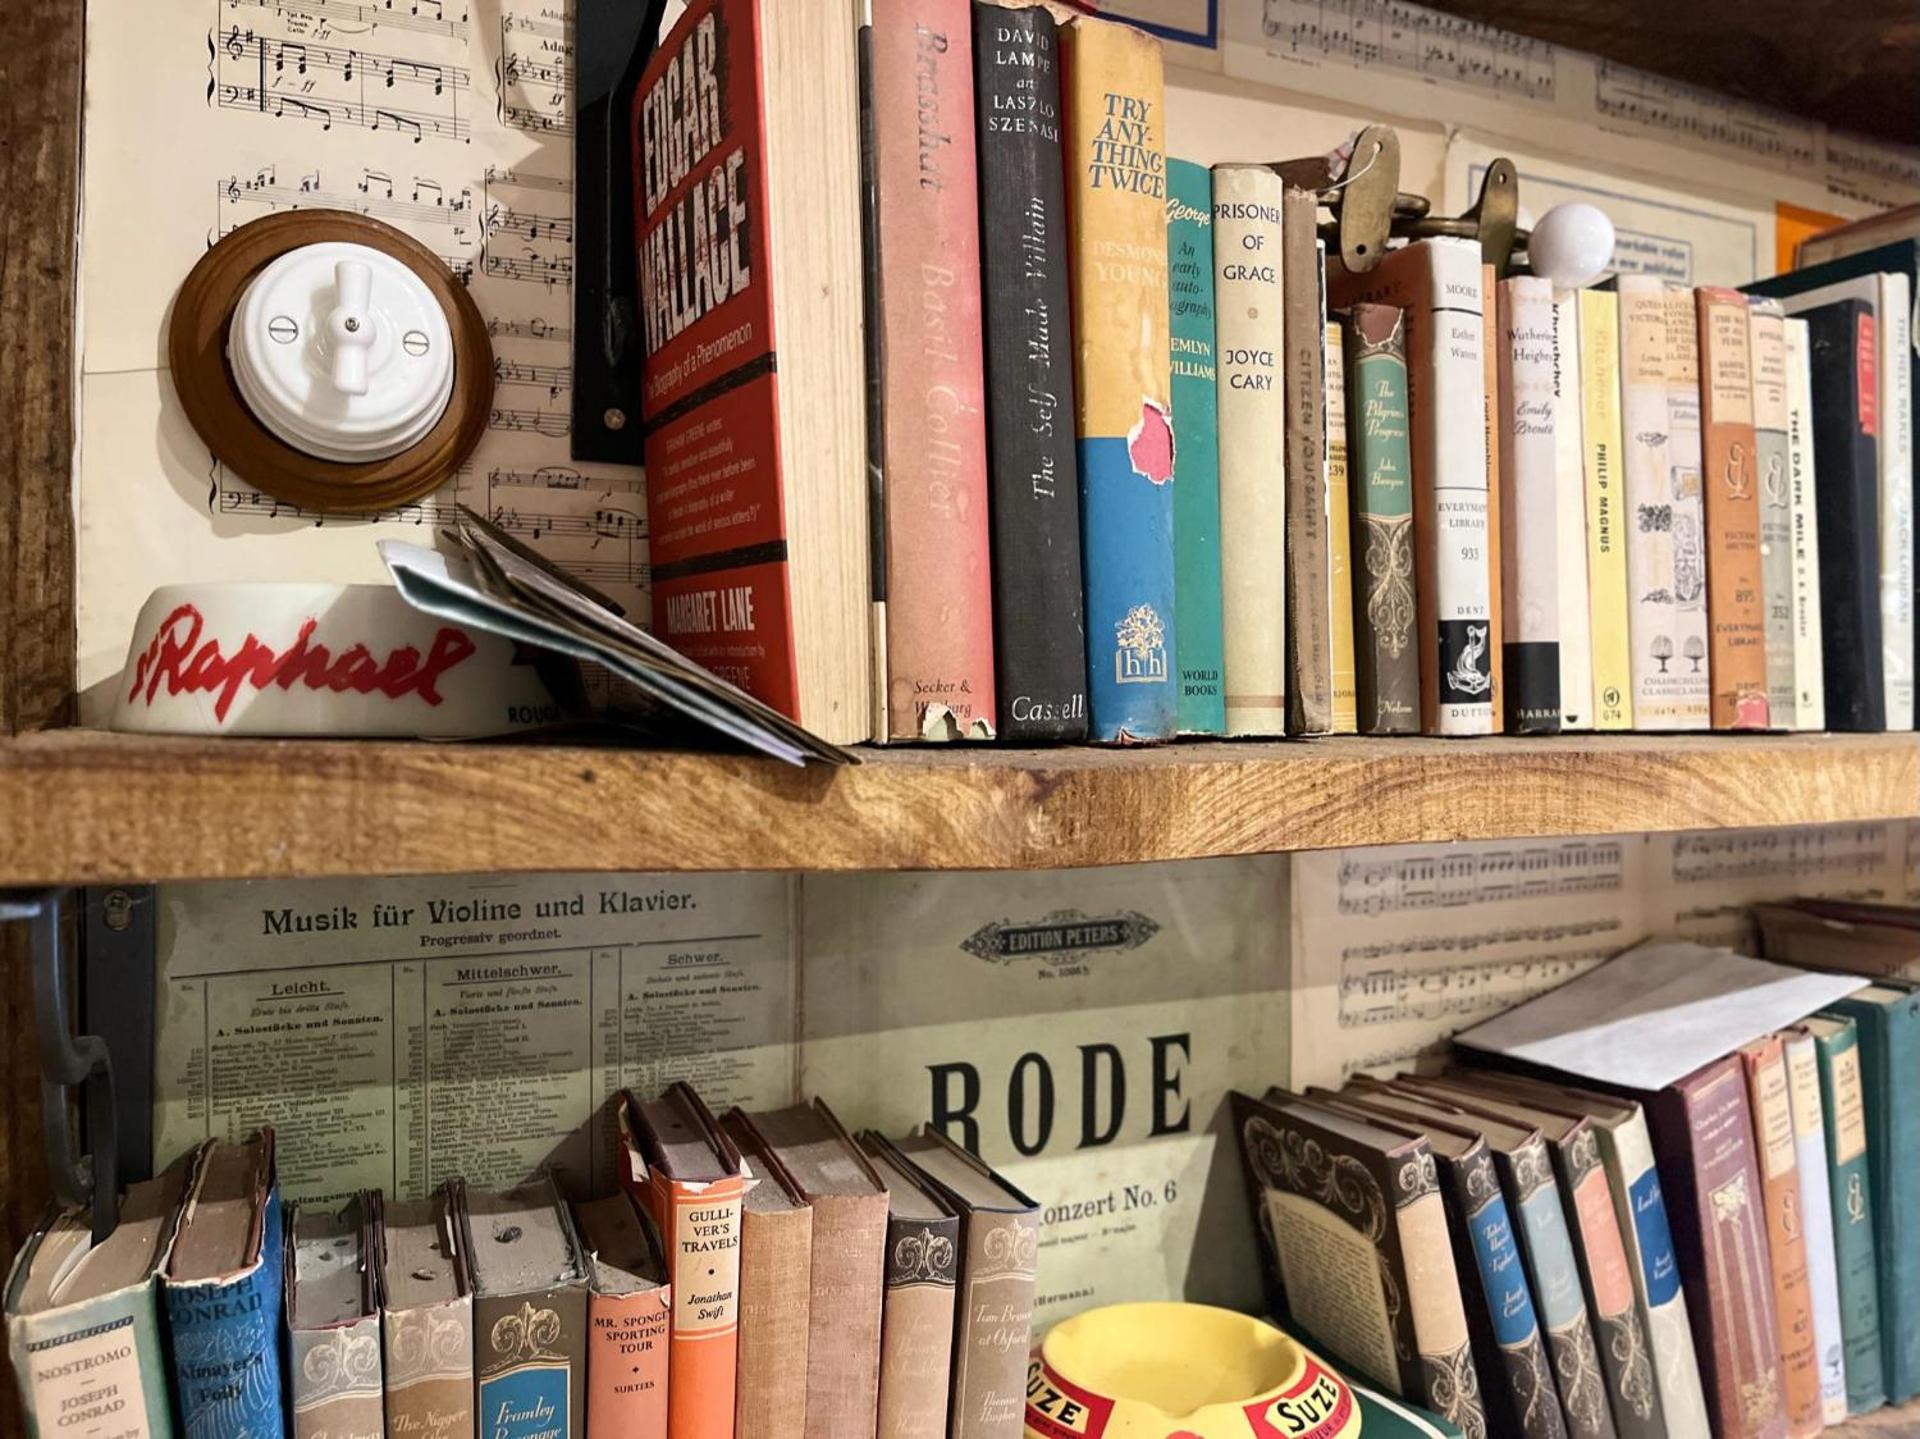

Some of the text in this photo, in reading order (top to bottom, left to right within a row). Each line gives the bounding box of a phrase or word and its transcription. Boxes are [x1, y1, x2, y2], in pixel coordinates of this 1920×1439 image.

[997, 27, 1050, 51] DAVID
[995, 51, 1051, 74] LAMPE
[642, 11, 723, 218] EDGAR
[993, 94, 1055, 120] LASZLO
[1103, 93, 1152, 124] TRY
[988, 117, 1059, 144] SZENASI
[1096, 117, 1153, 147] ANY-
[1091, 140, 1163, 172] THING
[1088, 163, 1165, 200] TWICE
[1166, 198, 1213, 229] George
[1213, 203, 1281, 225] PRISONER
[639, 145, 751, 358] WALLACE
[1178, 241, 1196, 257] An
[1242, 235, 1265, 251] OF
[1172, 262, 1202, 279] early
[1223, 264, 1276, 284] GRACE
[1446, 283, 1478, 298] MOORE
[697, 322, 753, 369] Phenomenon
[1022, 196, 1058, 501] The Self Made Villain
[1170, 337, 1211, 357] EMLYN
[1552, 302, 1562, 398] Khrushchev
[1226, 349, 1274, 368] JOYCE
[921, 263, 967, 520] Basil Collier
[1230, 373, 1272, 391] CARY
[1300, 349, 1314, 425] CITIZEN
[1375, 379, 1395, 398] The
[1516, 400, 1553, 421] Emily
[1371, 471, 1405, 492] Bunyan
[1790, 409, 1806, 561] THE DARK MILE
[1597, 443, 1611, 554] PHILIP MAGNUS
[666, 585, 755, 635] MARGARET LANE
[1456, 605, 1485, 615] DENT
[914, 678, 973, 695] Secker &
[1182, 670, 1219, 682] WORLD
[1184, 685, 1218, 697] BOOKS
[508, 704, 562, 726] ROUG
[1011, 693, 1084, 722] Casell
[262, 889, 698, 935] Musik für Violine und Klavier.
[420, 929, 562, 949] Progressiv geordnet.
[1009, 923, 1120, 951] EDITION PETERS
[667, 951, 724, 966] Schwer.
[457, 963, 563, 982] Mittelschwer.
[271, 980, 332, 996] Leicht.
[627, 992, 639, 1002] A.
[642, 988, 696, 1000] Solostücke
[699, 985, 717, 996] und
[433, 998, 583, 1018] A. Solostücke und Sonaten.
[216, 1015, 384, 1038] A. Solostücke und Sonaten.
[924, 1031, 1192, 1158] RODE
[1038, 1180, 1178, 1227] onzert No. 6
[688, 1207, 734, 1224] GULLI-
[692, 1222, 731, 1238] VER'S
[681, 1235, 739, 1255] TRAVELS
[687, 1290, 734, 1306] Jonathan
[593, 1317, 618, 1329] MR.
[697, 1305, 724, 1321] Swift
[975, 1303, 1000, 1323] Tom
[605, 1325, 666, 1343] SPORTING
[977, 1333, 991, 1347] at
[619, 1340, 654, 1355] TOUR
[37, 1345, 132, 1383] NOSTROMO
[60, 1383, 119, 1412] JOSEPH
[613, 1380, 655, 1395] SURTEES
[56, 1398, 126, 1427] CONRAD
[495, 1395, 556, 1428] Framley
[1276, 1377, 1337, 1434] SUZE
[393, 1414, 422, 1433] The
